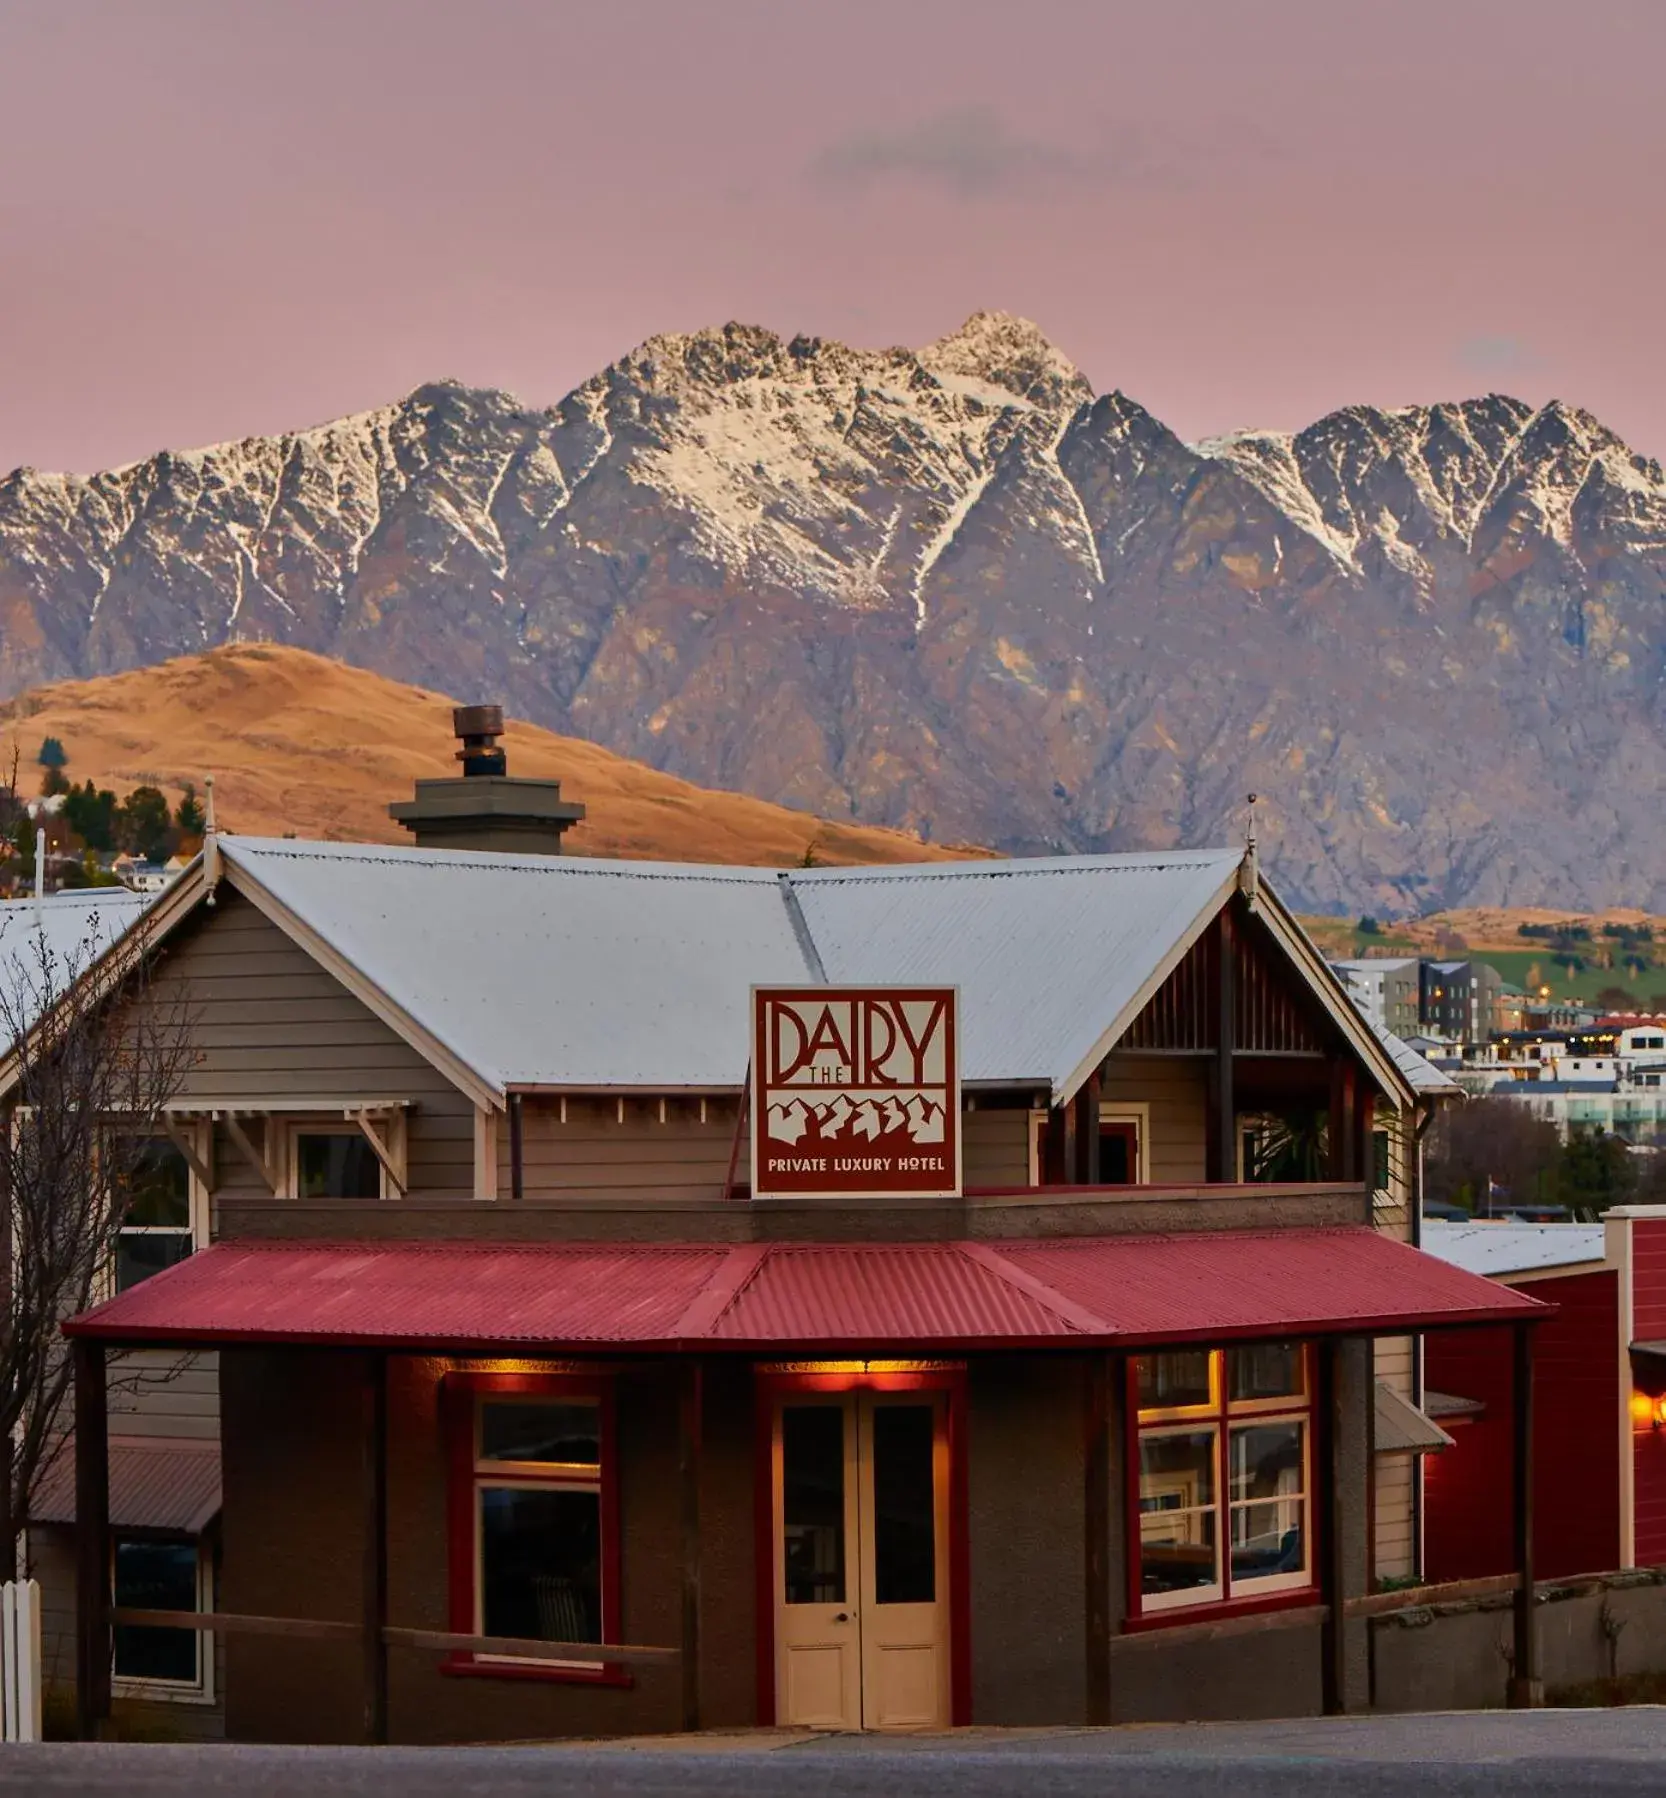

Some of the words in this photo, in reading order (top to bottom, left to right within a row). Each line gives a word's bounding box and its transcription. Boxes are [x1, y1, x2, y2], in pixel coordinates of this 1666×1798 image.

[771, 1001, 946, 1083] DAIRY
[809, 1066, 843, 1083] THE
[768, 1158, 827, 1172] PRIVATE
[834, 1158, 892, 1171] LUXURY
[898, 1157, 945, 1171] HOTEL
